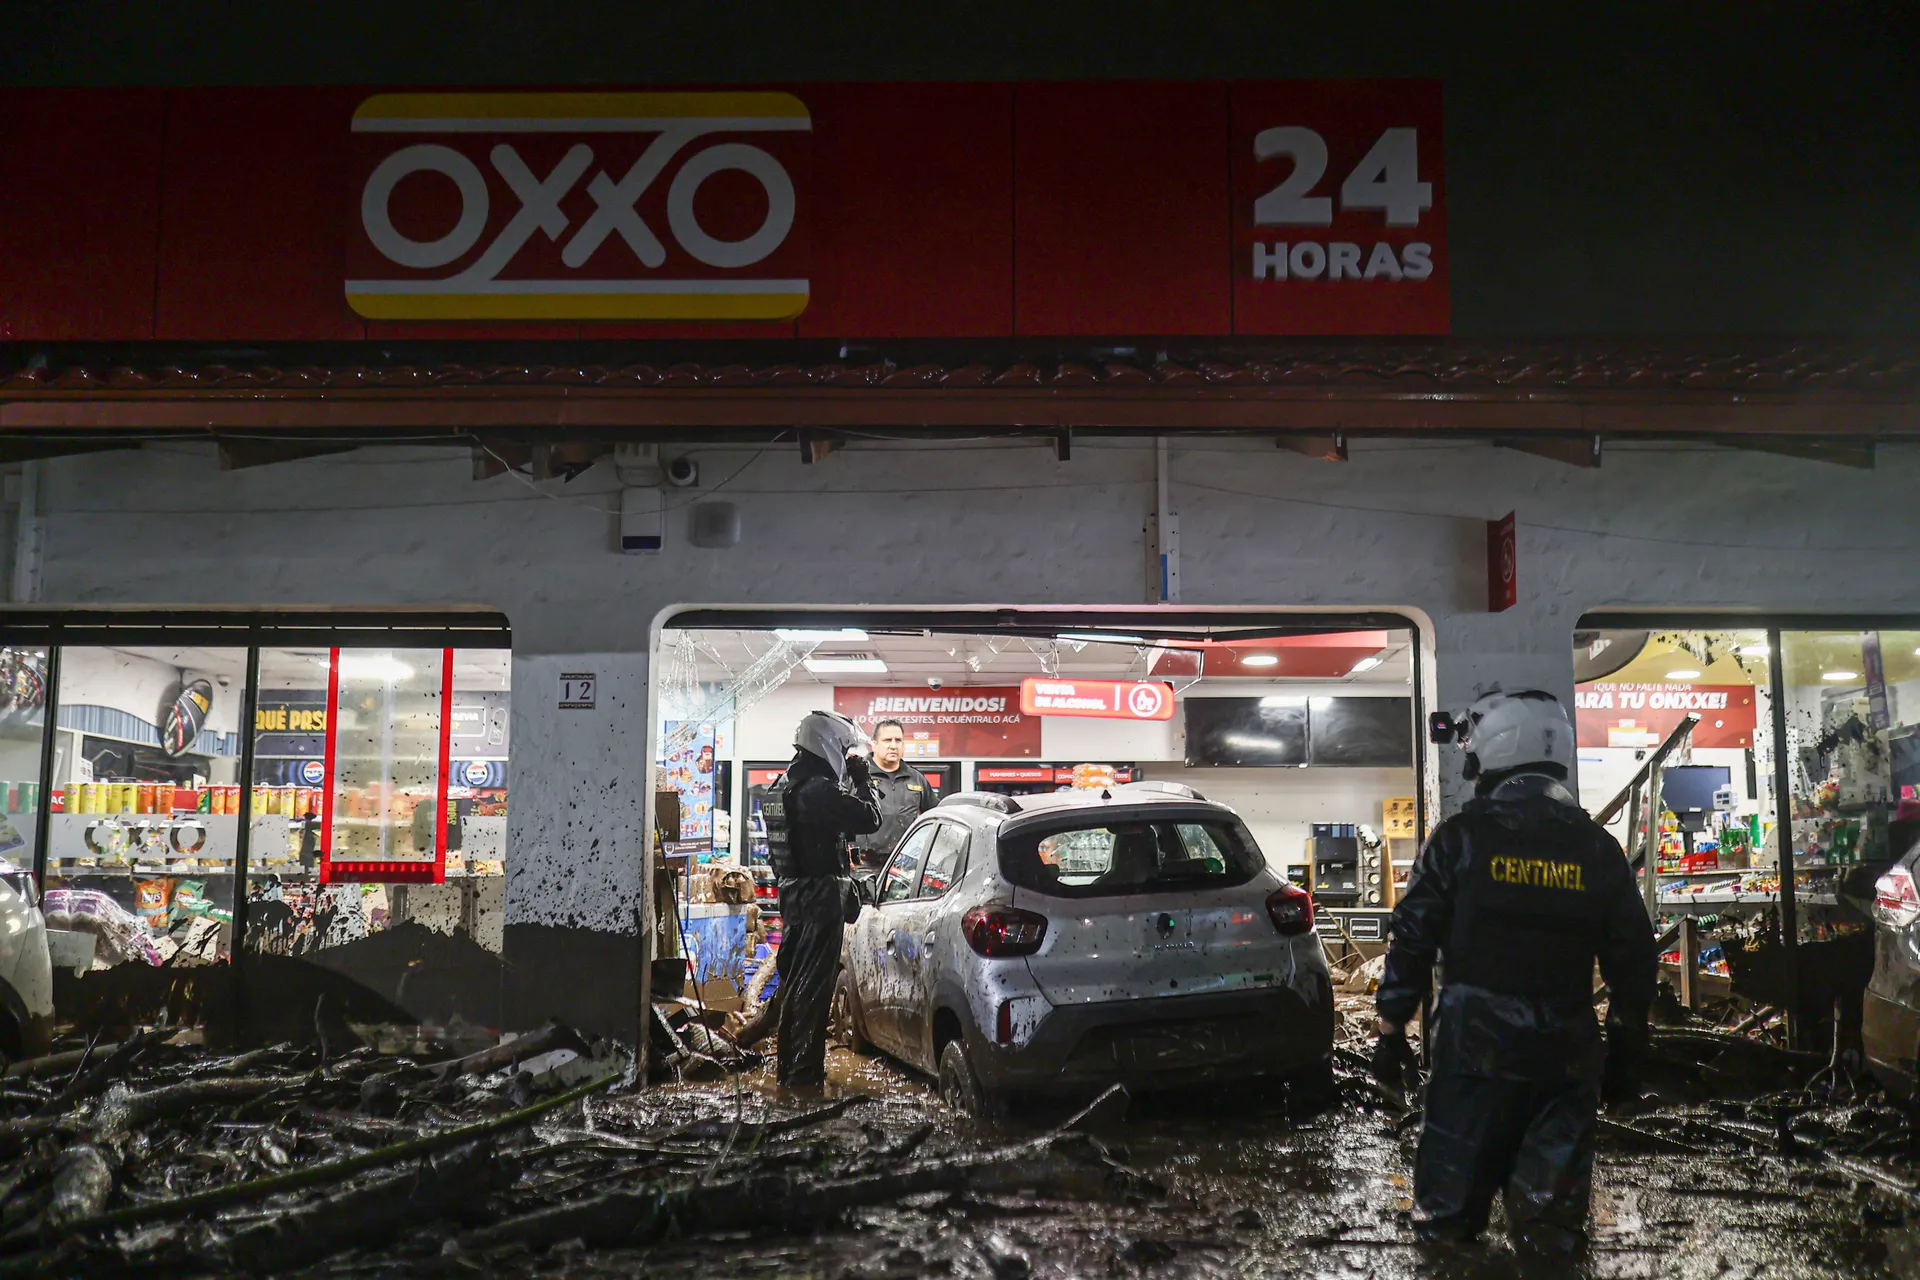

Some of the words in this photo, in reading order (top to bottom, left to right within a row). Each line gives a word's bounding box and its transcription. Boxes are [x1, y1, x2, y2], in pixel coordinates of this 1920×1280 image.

[1253, 126, 1433, 227] 24
[360, 140, 797, 280] OXXO
[1253, 241, 1434, 281] HORAS
[565, 681, 592, 701] 12
[868, 697, 1006, 716] ¡BIENVENIDOS!
[1575, 692, 1614, 709] ARA
[1618, 692, 1646, 709] TU
[1649, 692, 1728, 709] ONXXE!
[937, 714, 1000, 724] ENCUÉNTRALO
[1002, 714, 1020, 724] ACÁ
[84, 817, 207, 857] OXXO
[1490, 855, 1586, 891] CENTINEL
